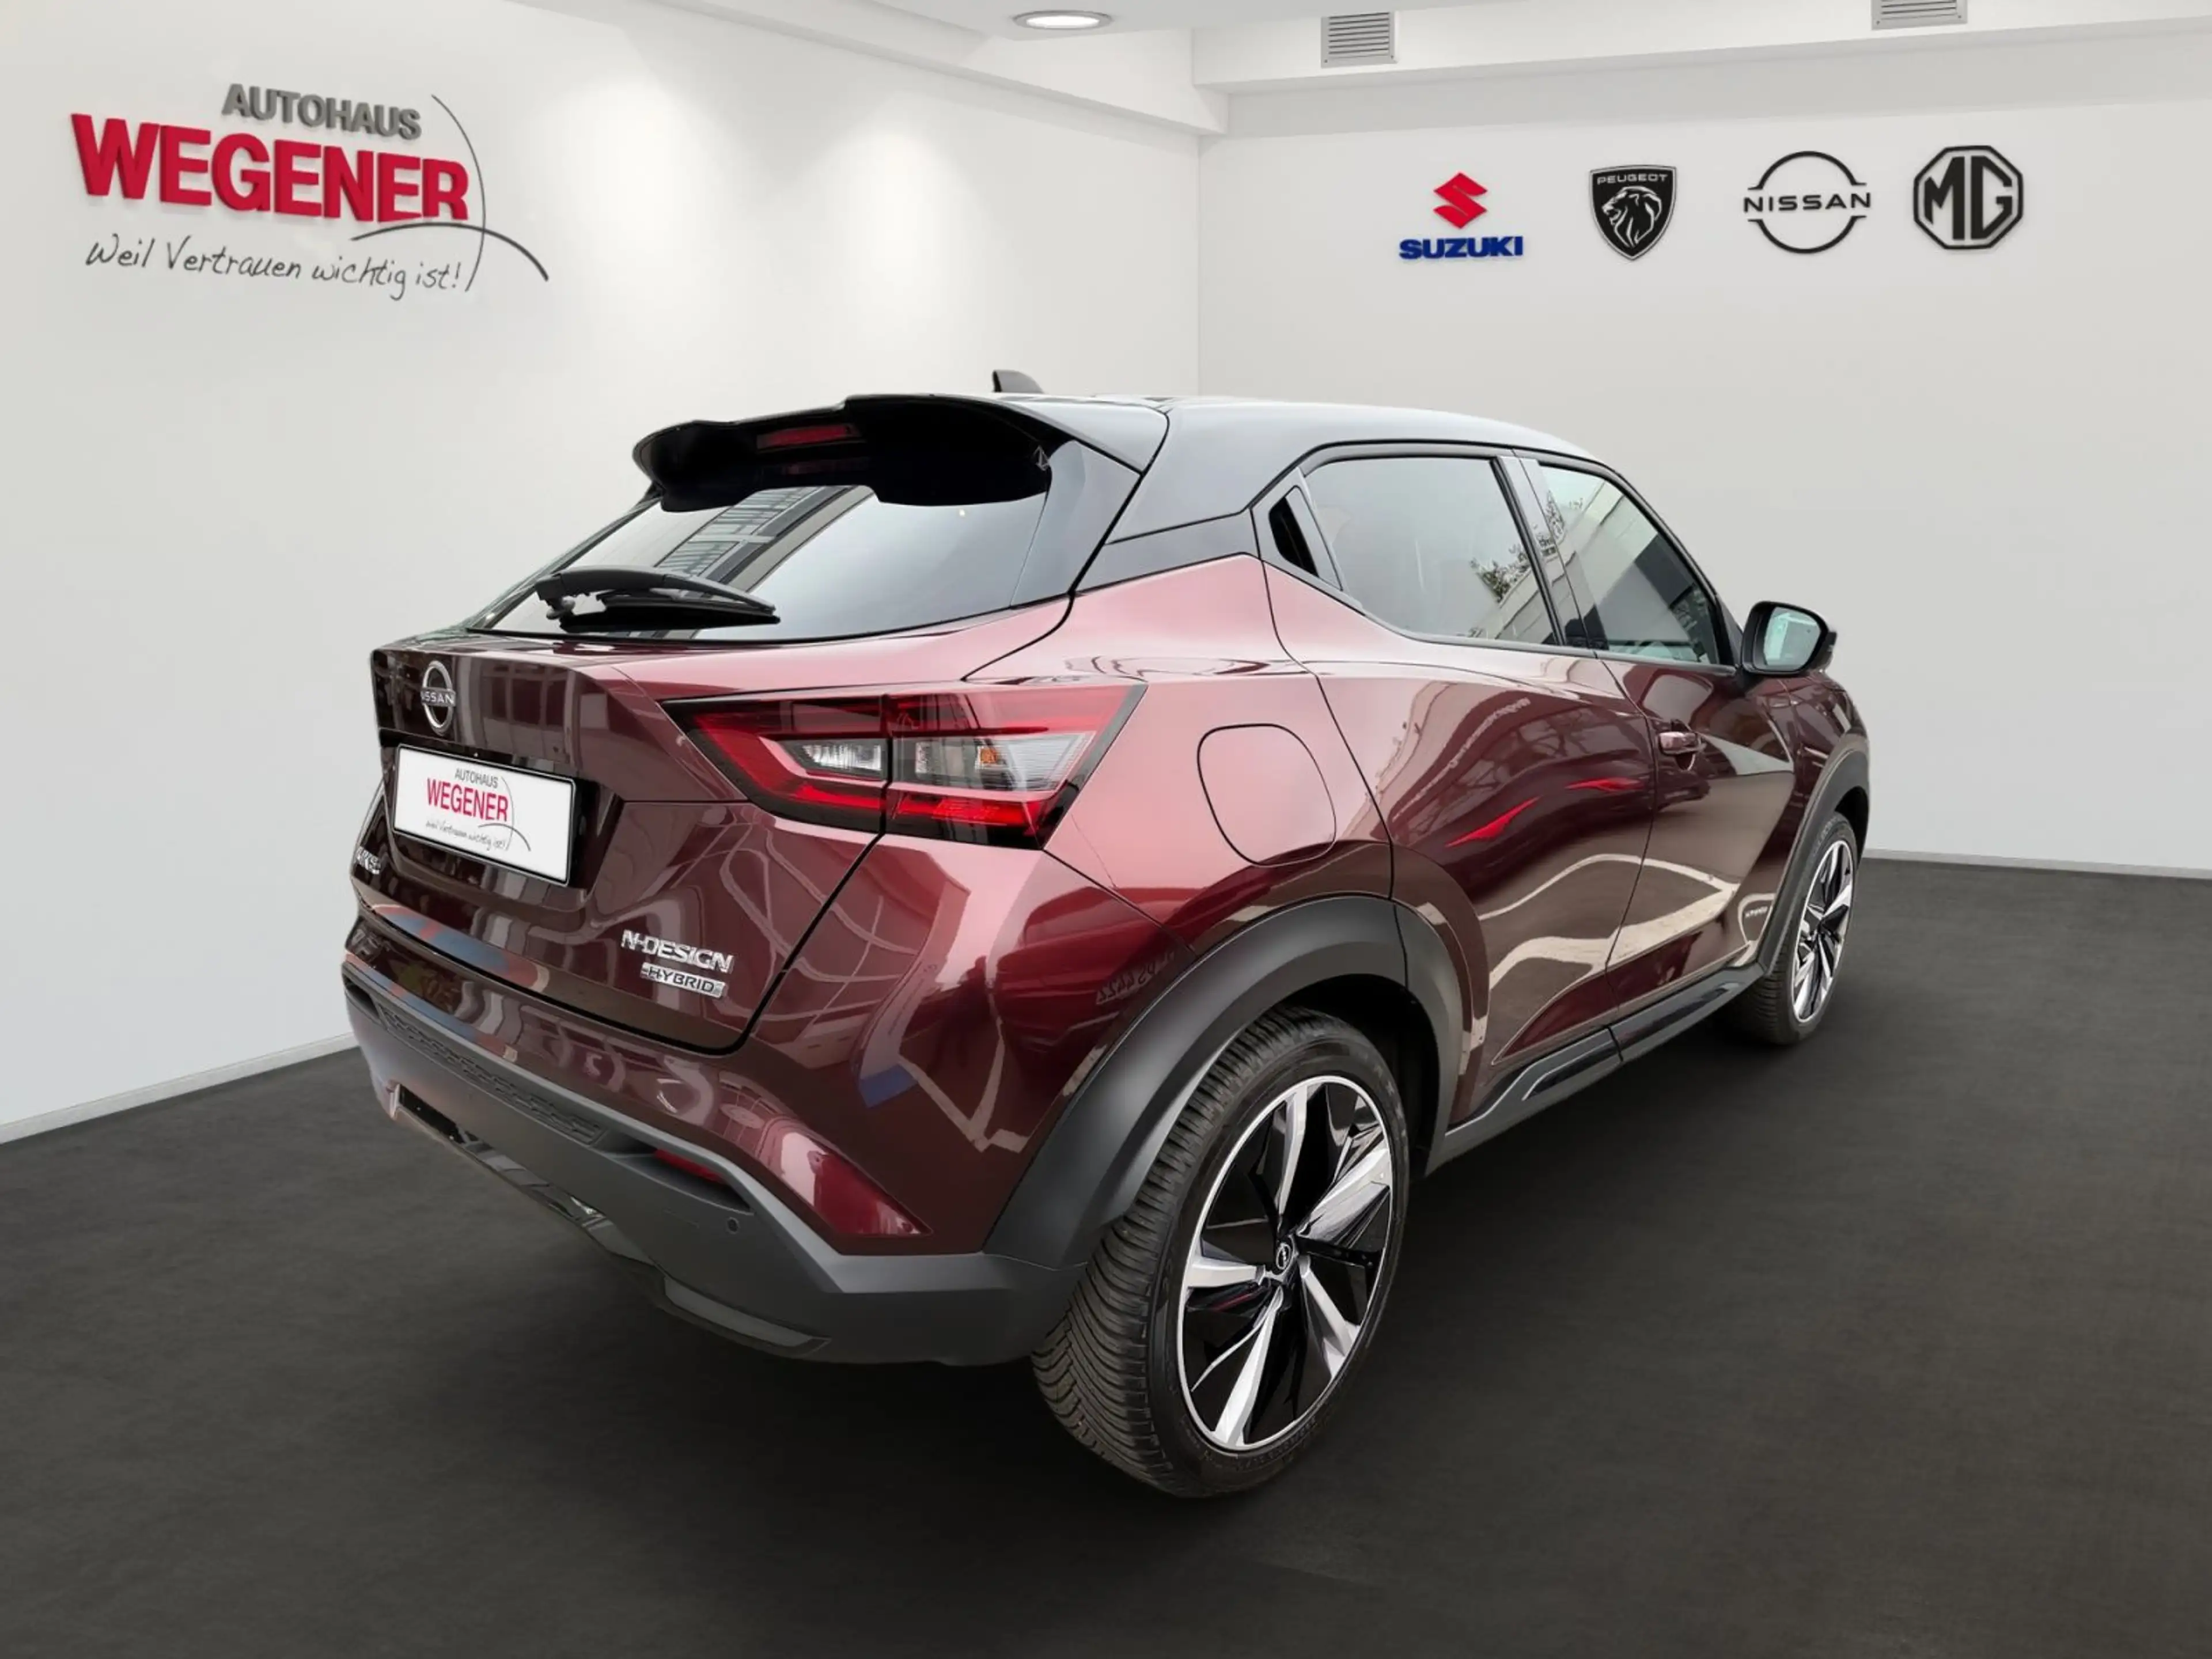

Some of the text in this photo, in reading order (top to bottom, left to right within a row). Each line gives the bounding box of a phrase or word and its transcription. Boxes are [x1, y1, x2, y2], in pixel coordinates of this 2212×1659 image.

[222, 84, 422, 140] AUTOHAUS
[71, 113, 469, 222] WEGENER
[1596, 173, 1669, 185] PEUGEOT
[1744, 192, 1871, 213] NISSAN
[1924, 155, 2013, 241] MG
[85, 233, 461, 301] Weil Vertrauen wichtig ist!
[1399, 236, 1524, 260] SUZUKI
[427, 778, 509, 822] WEGENER
[454, 768, 499, 789] AUTOHAUS
[621, 929, 734, 974] N-DESIGN
[648, 966, 714, 993] HYBRID
